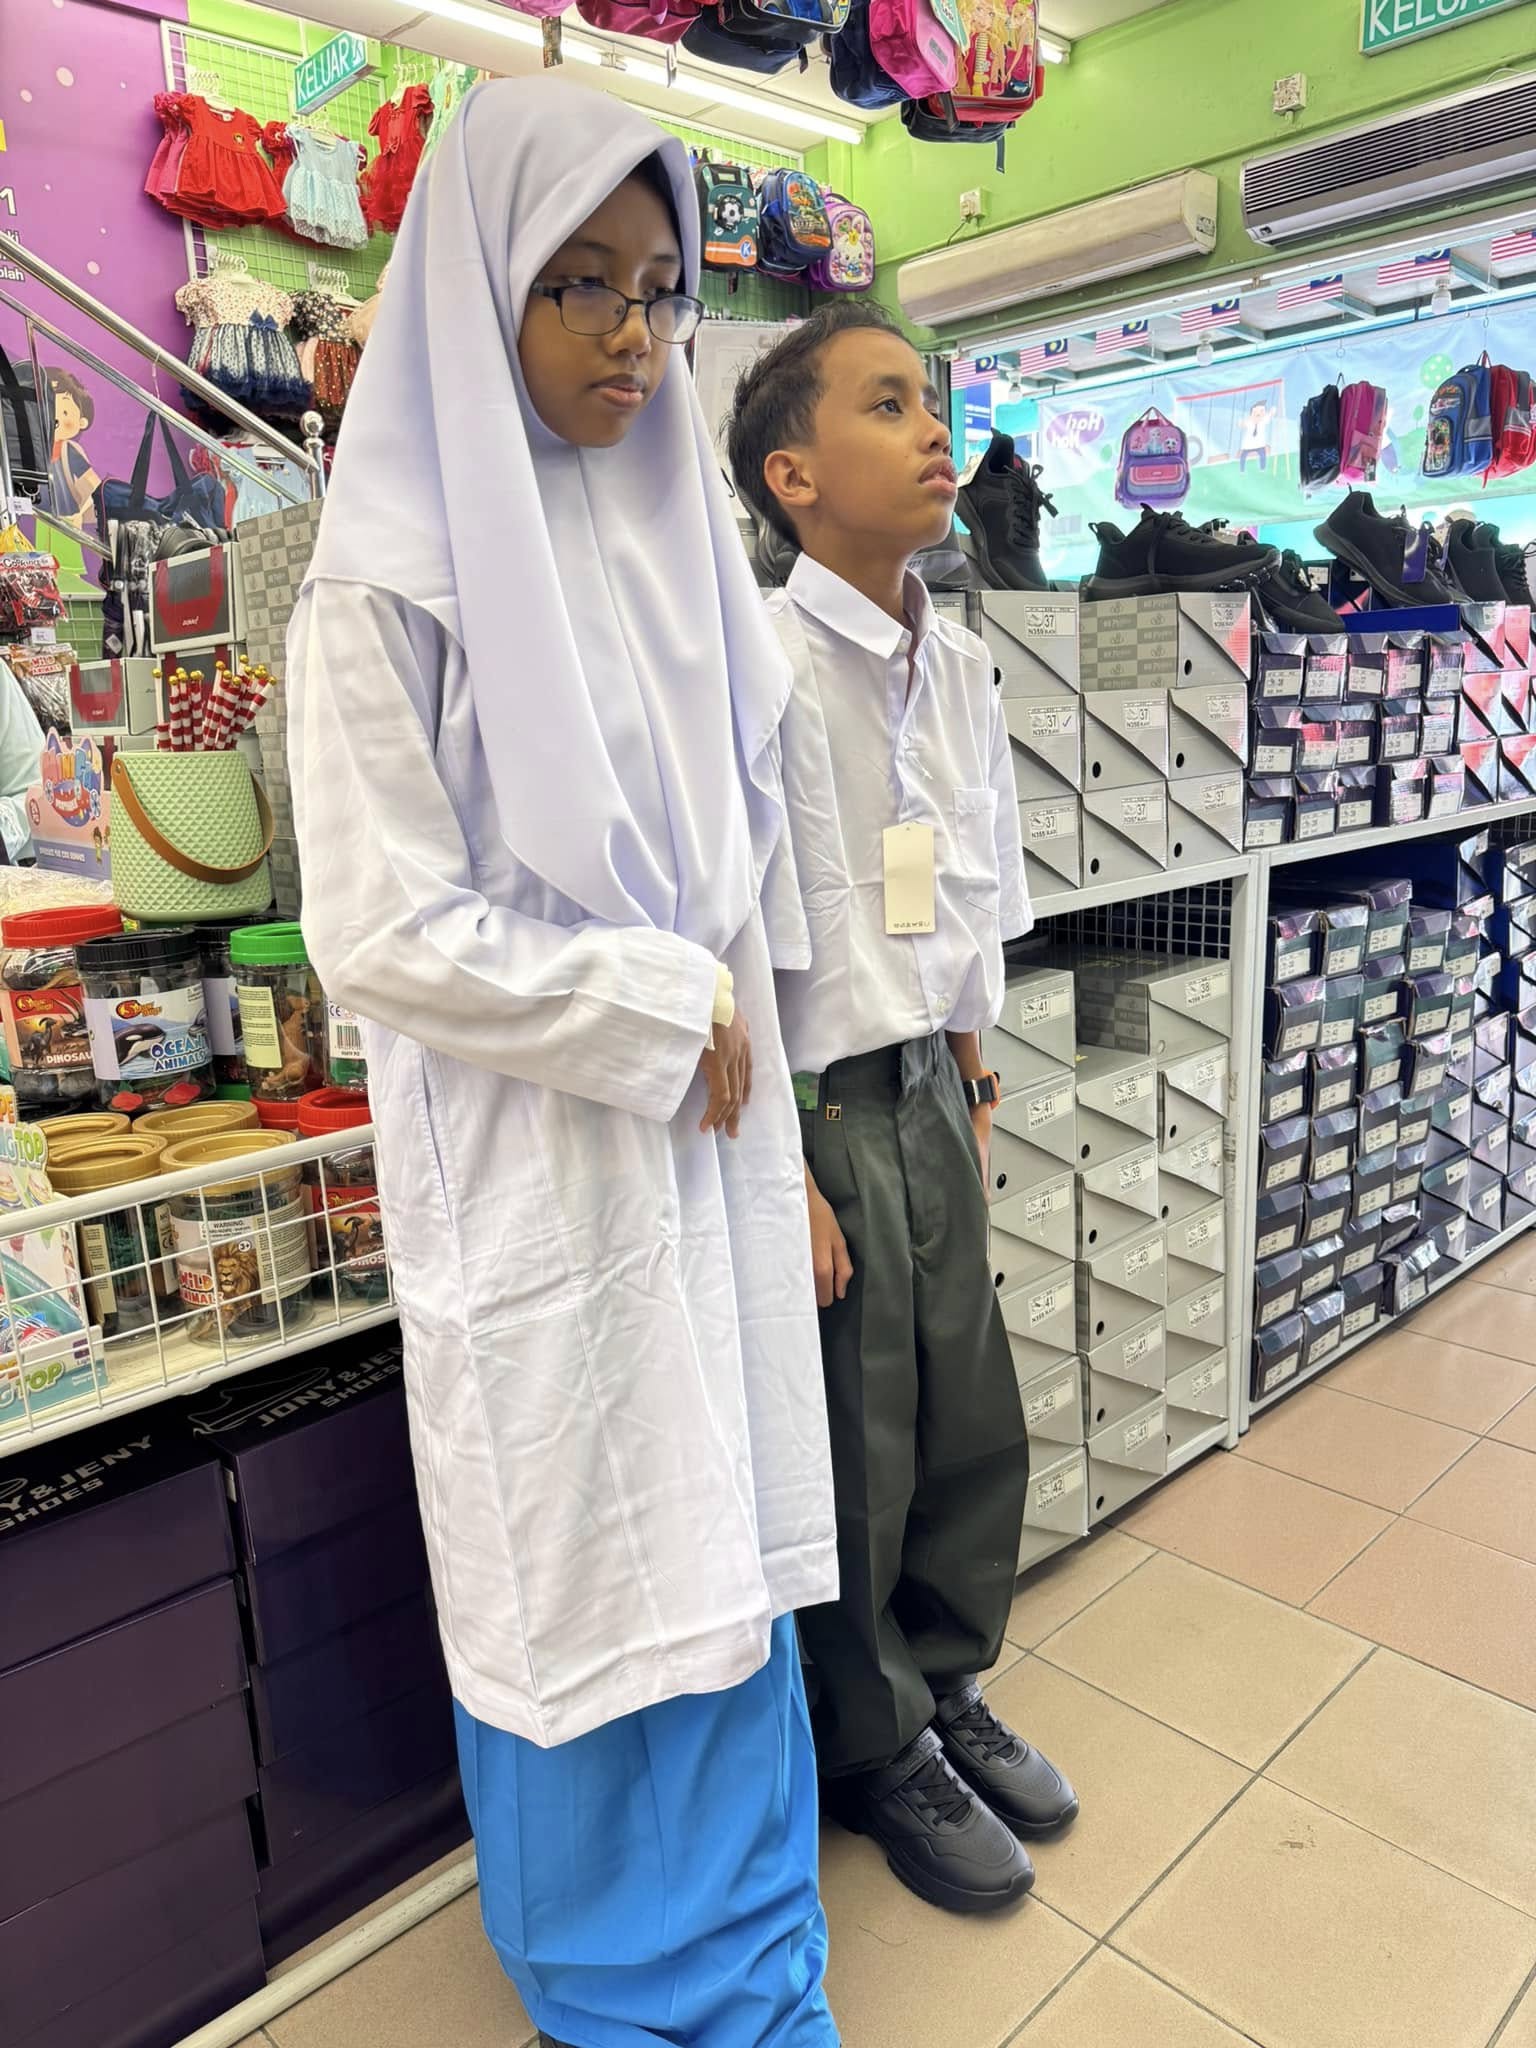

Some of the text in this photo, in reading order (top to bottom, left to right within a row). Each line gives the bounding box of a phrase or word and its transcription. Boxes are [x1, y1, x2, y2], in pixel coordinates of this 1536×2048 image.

[296, 37, 351, 106] KELUAR
[1044, 614, 1054, 628] 37
[1047, 714, 1057, 727] 37
[1140, 708, 1148, 720] 37
[1137, 803, 1145, 815] 37
[1046, 815, 1055, 828] 37
[1039, 1000, 1047, 1011] 41
[151, 1033, 208, 1059] OCEAN
[1044, 1100, 1053, 1112] 41
[13, 1128, 44, 1167] TOP
[1042, 1196, 1050, 1208] 41
[1045, 1295, 1053, 1306] 41
[319, 1363, 401, 1407] SHOES
[258, 1379, 336, 1427] JONY
[60, 1434, 152, 1488] JENY
[0, 1478, 104, 1531] SHOES
